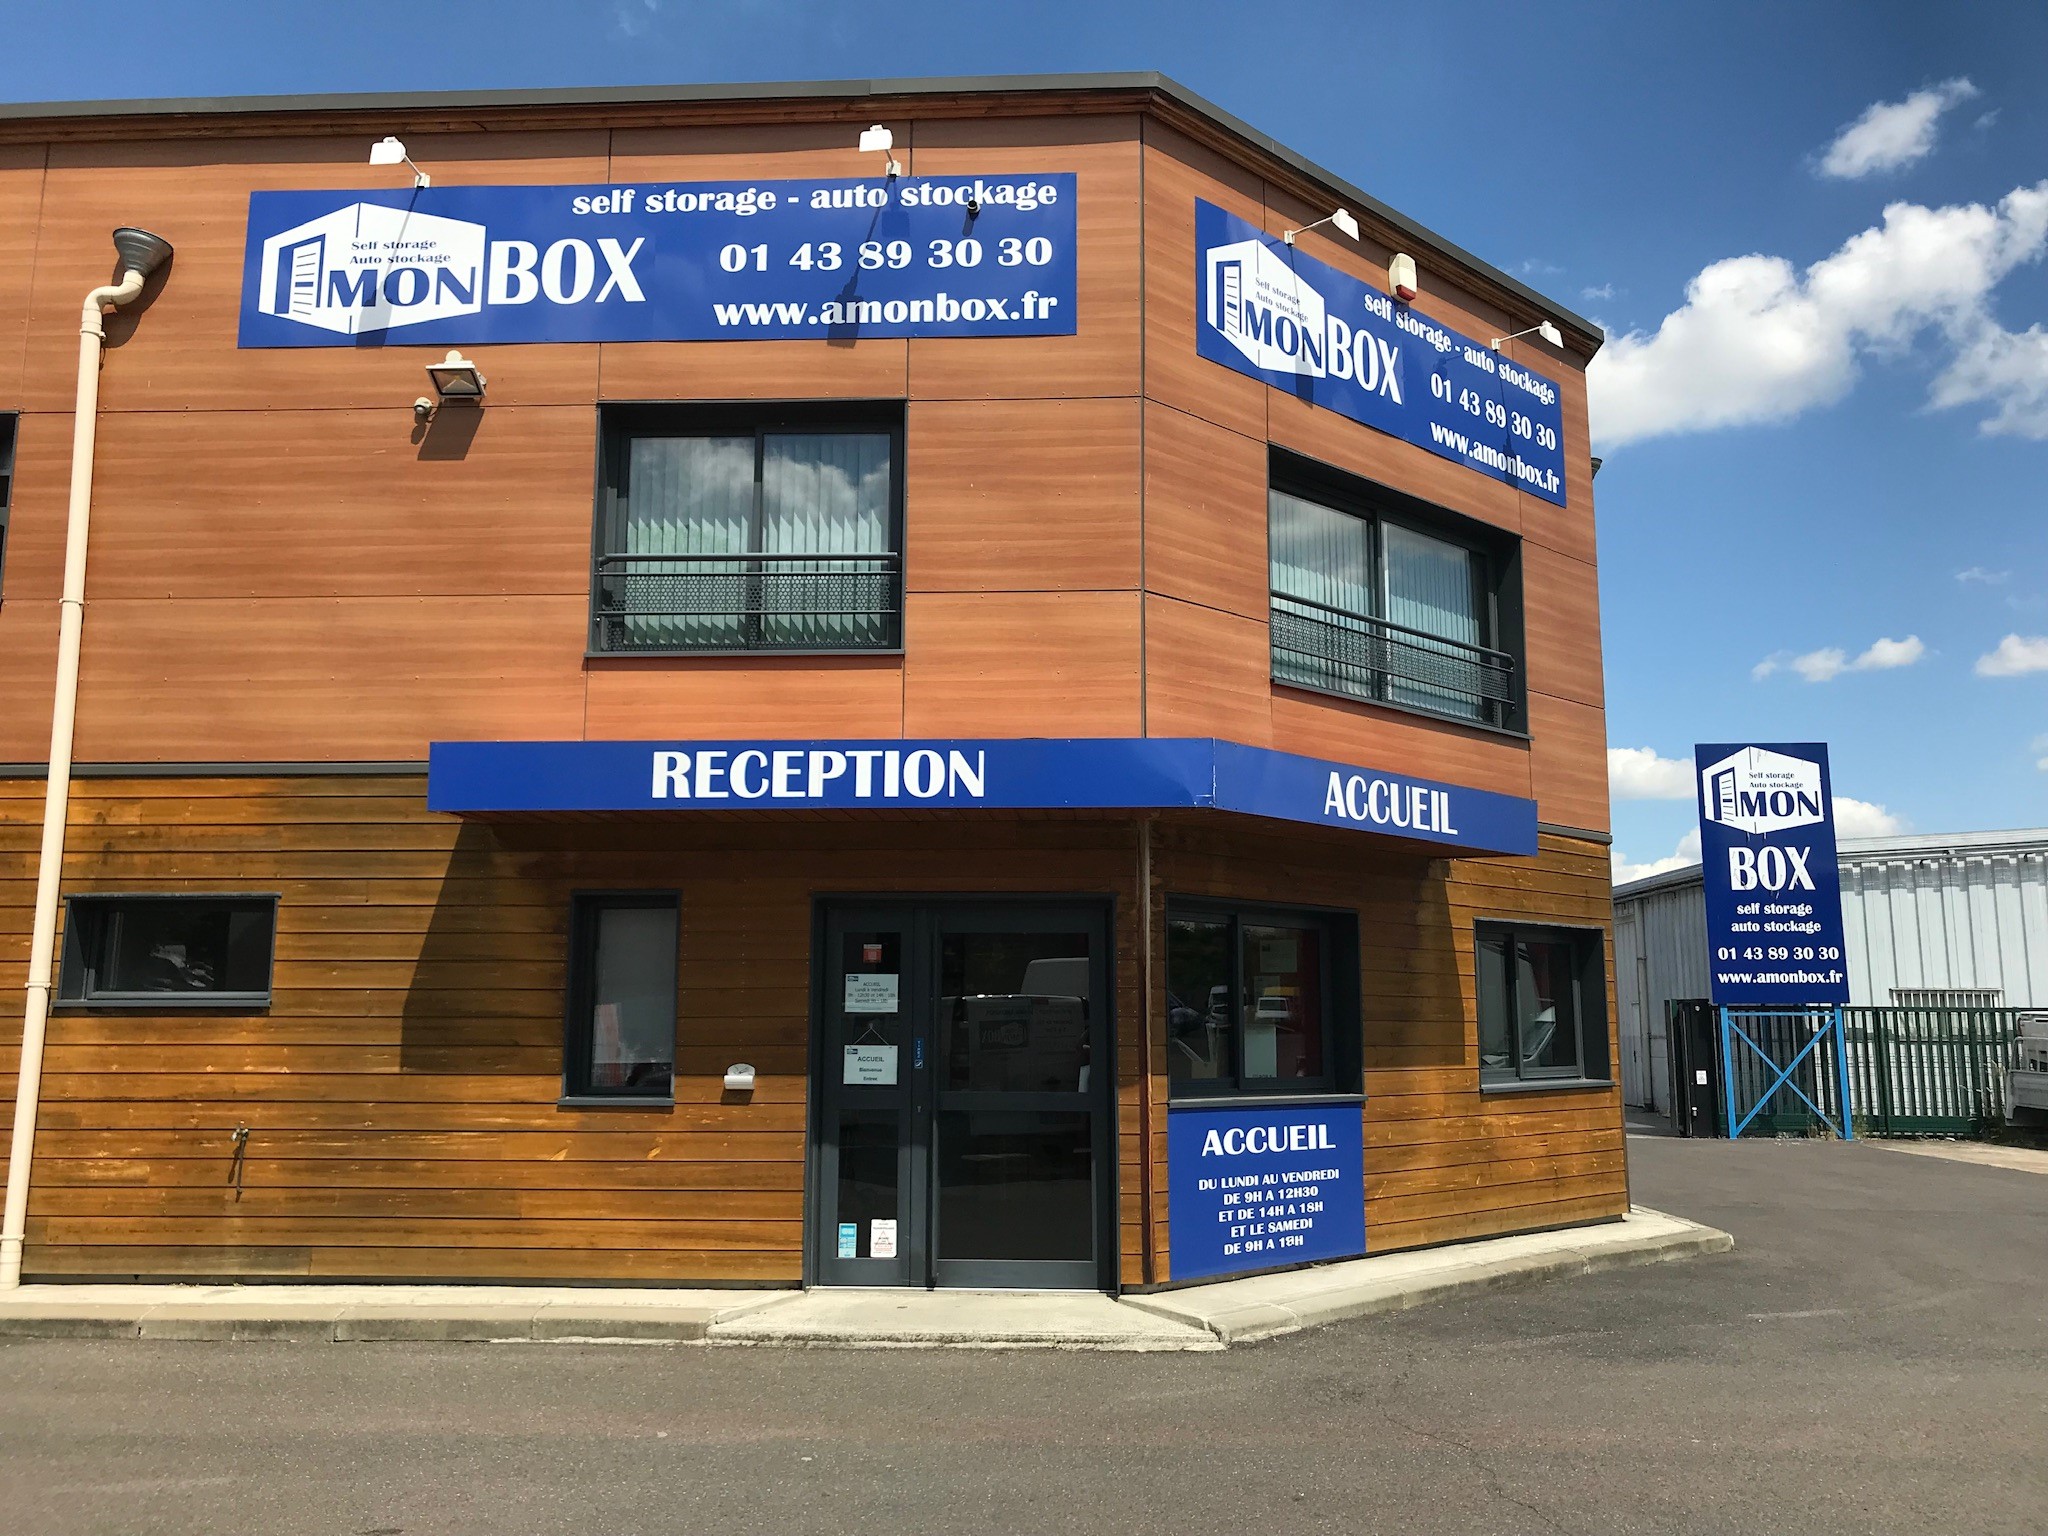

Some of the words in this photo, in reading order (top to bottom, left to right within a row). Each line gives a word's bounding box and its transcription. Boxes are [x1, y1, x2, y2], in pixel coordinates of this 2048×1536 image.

[572, 189, 635, 214] self
[645, 188, 776, 215] storage
[811, 185, 887, 208] auto
[901, 180, 1057, 211] stockage
[350, 255, 382, 265] Auto
[387, 252, 451, 264] stockage
[351, 241, 379, 250] Self
[383, 240, 437, 250] storage
[720, 244, 767, 272] 01
[790, 243, 842, 270] 43
[859, 241, 911, 269] 89
[928, 239, 982, 267] 30
[998, 237, 1052, 266] 30
[488, 238, 645, 304] BOX
[1255, 277, 1270, 291] Self
[1272, 286, 1301, 306] storage
[713, 291, 1057, 325] www.amonbox.fr
[1255, 292, 1273, 306] Auto
[1275, 302, 1309, 322] stockage
[1327, 314, 1402, 404] BOX
[1365, 294, 1392, 322] self
[1395, 311, 1452, 352] storage
[1464, 346, 1494, 373] auto
[1499, 363, 1556, 405] stockage
[1431, 373, 1451, 403] 01
[1459, 389, 1480, 415] 43
[1486, 400, 1506, 428] 89
[1512, 412, 1531, 439] 30
[1536, 424, 1555, 450] 30
[1430, 422, 1559, 494] www.amonbox.fr
[652, 750, 984, 798] RECEPTION
[1769, 781, 1803, 789] stockage
[1324, 770, 1459, 834] ACCUEIL
[1729, 846, 1815, 890] BOX
[1737, 903, 1760, 914] self
[1764, 903, 1812, 916] storage
[1732, 921, 1760, 931] auto
[1764, 921, 1821, 934] stockage
[1718, 948, 1736, 960] 01
[1744, 947, 1763, 959] 43
[1768, 947, 1788, 960] 89
[1794, 947, 1813, 959] 30
[1819, 947, 1839, 959] 30
[1718, 970, 1843, 983] www.amonbox.fr
[1202, 1125, 1336, 1156] ACCUEIL
[1198, 1179, 1217, 1190] DU
[1221, 1176, 1258, 1188] LUNDI
[1262, 1174, 1278, 1184] AU
[1282, 1169, 1339, 1183] VENDREDI
[1224, 1193, 1240, 1205] DE
[1245, 1191, 1262, 1203] 9H
[1266, 1191, 1274, 1201] A
[1278, 1186, 1318, 1200] 12H30
[1219, 1211, 1233, 1223] ET
[1238, 1209, 1254, 1220] DE
[1259, 1205, 1284, 1218] 14H
[1287, 1204, 1295, 1215] A
[1299, 1202, 1323, 1213] 18H
[1231, 1226, 1246, 1238] ET
[1250, 1224, 1264, 1235] LE
[1268, 1218, 1312, 1233] SAMEDI
[1224, 1243, 1241, 1255] DE
[1245, 1241, 1263, 1252] 9H
[1266, 1241, 1275, 1250] A
